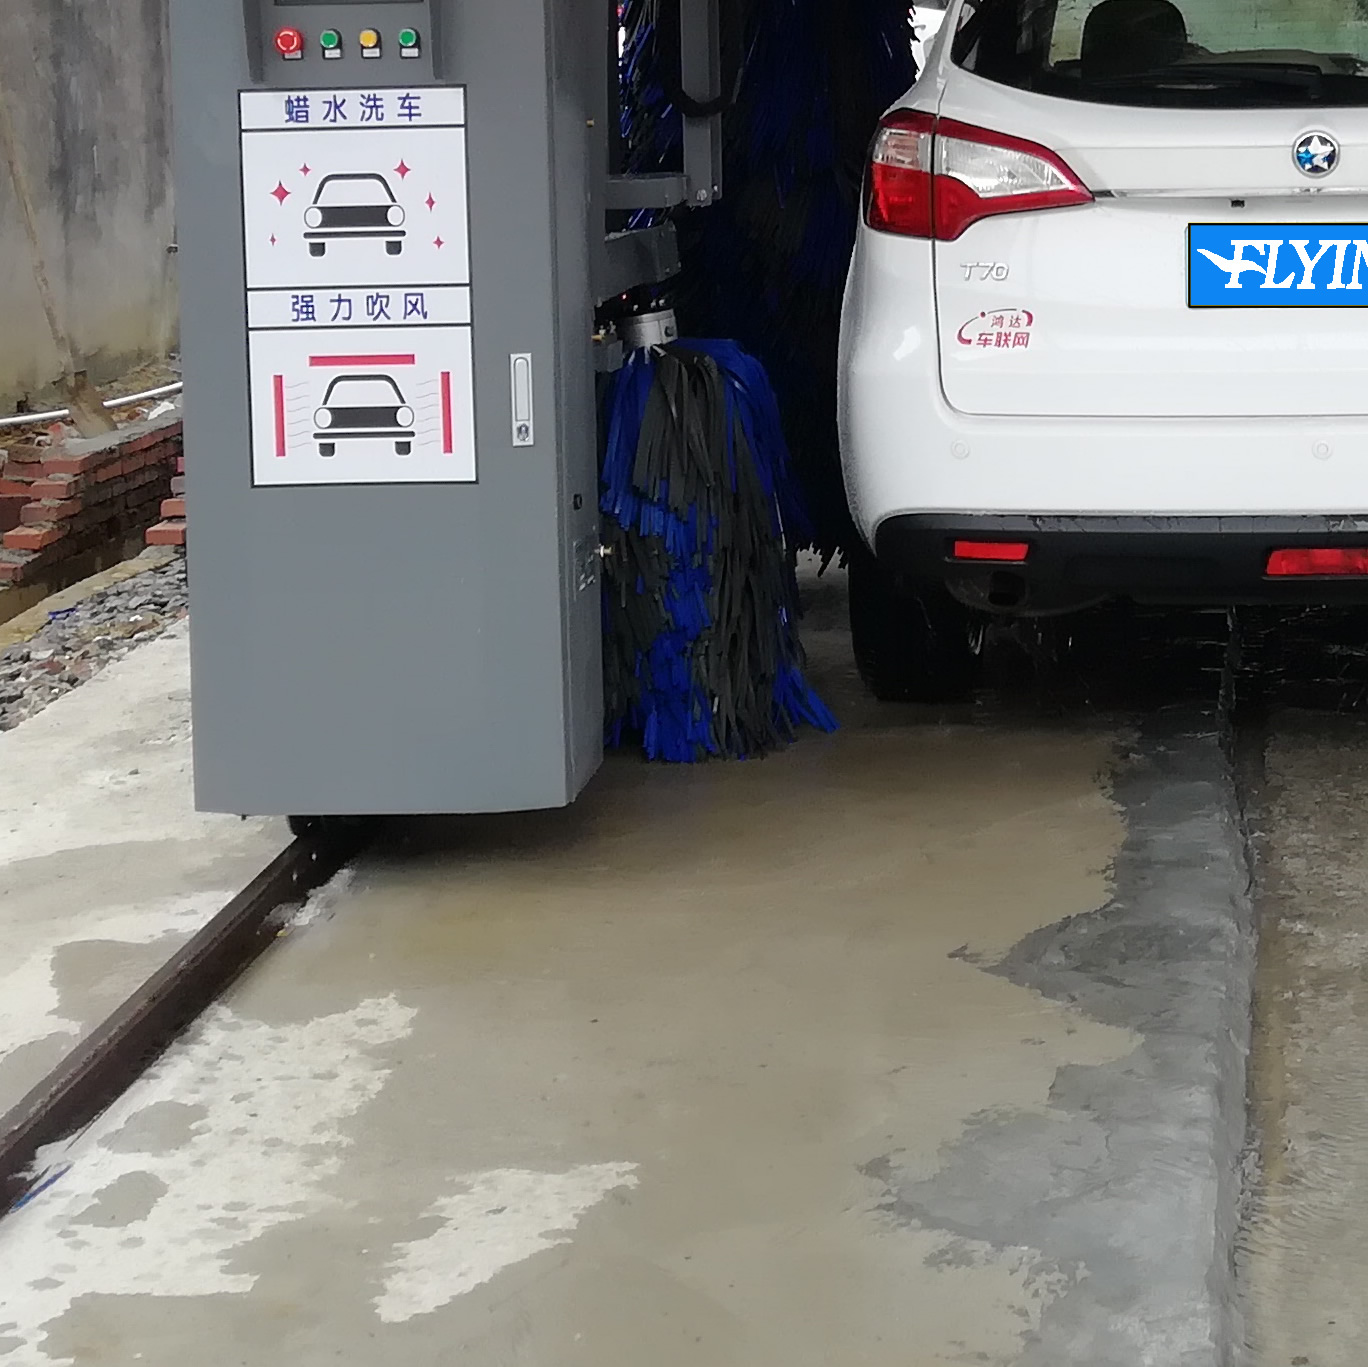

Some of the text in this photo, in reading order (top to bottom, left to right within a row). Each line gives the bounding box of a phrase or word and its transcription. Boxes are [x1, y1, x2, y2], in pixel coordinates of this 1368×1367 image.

[284, 92, 423, 124] 蜡水洗车
[960, 261, 1010, 281] T70
[290, 292, 429, 323] 强力吹风
[976, 331, 1031, 349] 车联网
